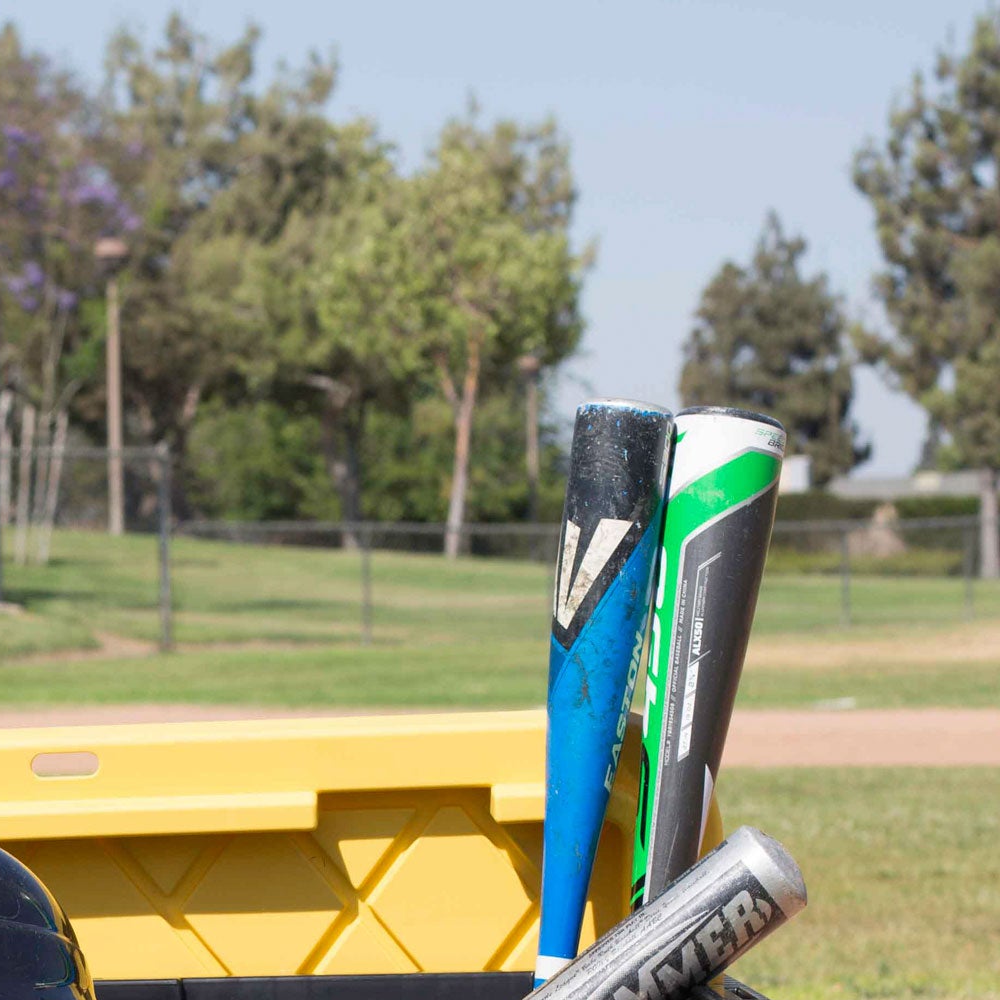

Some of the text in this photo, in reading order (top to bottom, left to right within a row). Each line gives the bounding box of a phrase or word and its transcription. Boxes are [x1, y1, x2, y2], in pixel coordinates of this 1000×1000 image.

[674, 634, 682, 664] BASEBALL
[691, 622, 703, 655] ALX50
[603, 633, 644, 795] EASTON
